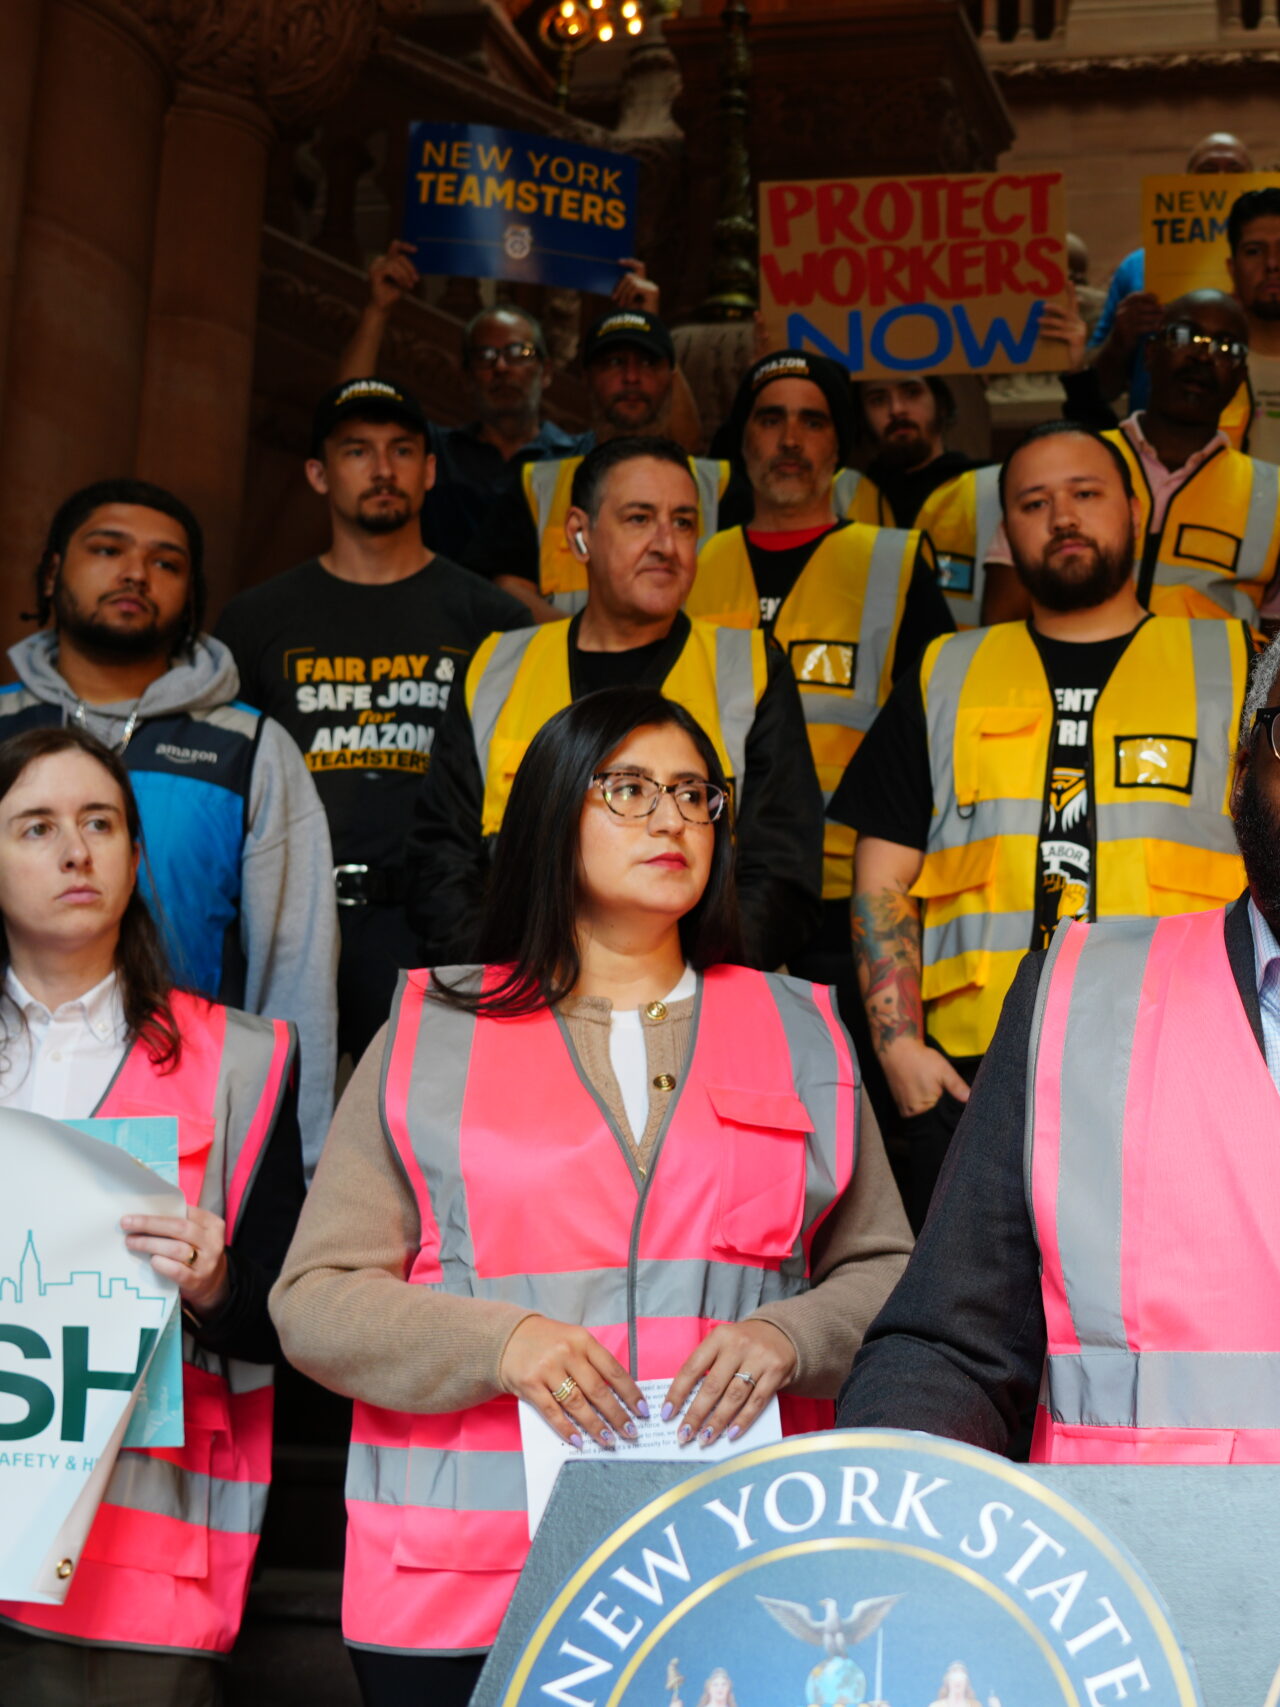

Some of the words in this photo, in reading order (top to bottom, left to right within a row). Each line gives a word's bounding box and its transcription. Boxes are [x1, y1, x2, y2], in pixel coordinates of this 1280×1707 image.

[423, 141, 513, 172] NEW
[528, 152, 622, 195] YORK
[416, 172, 626, 229] TEAMSTERS
[767, 173, 1062, 247] PROTECT
[1155, 191, 1227, 213] NEW
[760, 238, 1067, 306] WORKERS
[787, 300, 1046, 373] NOW
[296, 657, 366, 683] FAIR
[371, 655, 429, 682] PAY
[435, 657, 455, 682] &
[296, 683, 372, 713] SAFE
[376, 680, 451, 711] JOBS
[357, 709, 397, 726] for
[1057, 719, 1088, 746] RI
[155, 743, 218, 764] amazon
[310, 722, 434, 754] AMAZON
[310, 751, 431, 770] TEAMSTERS
[65, 1455, 77, 1470] &
[541, 1522, 692, 1707] NEW
[704, 1466, 951, 1551] YORK
[959, 1500, 1152, 1707] STATE
